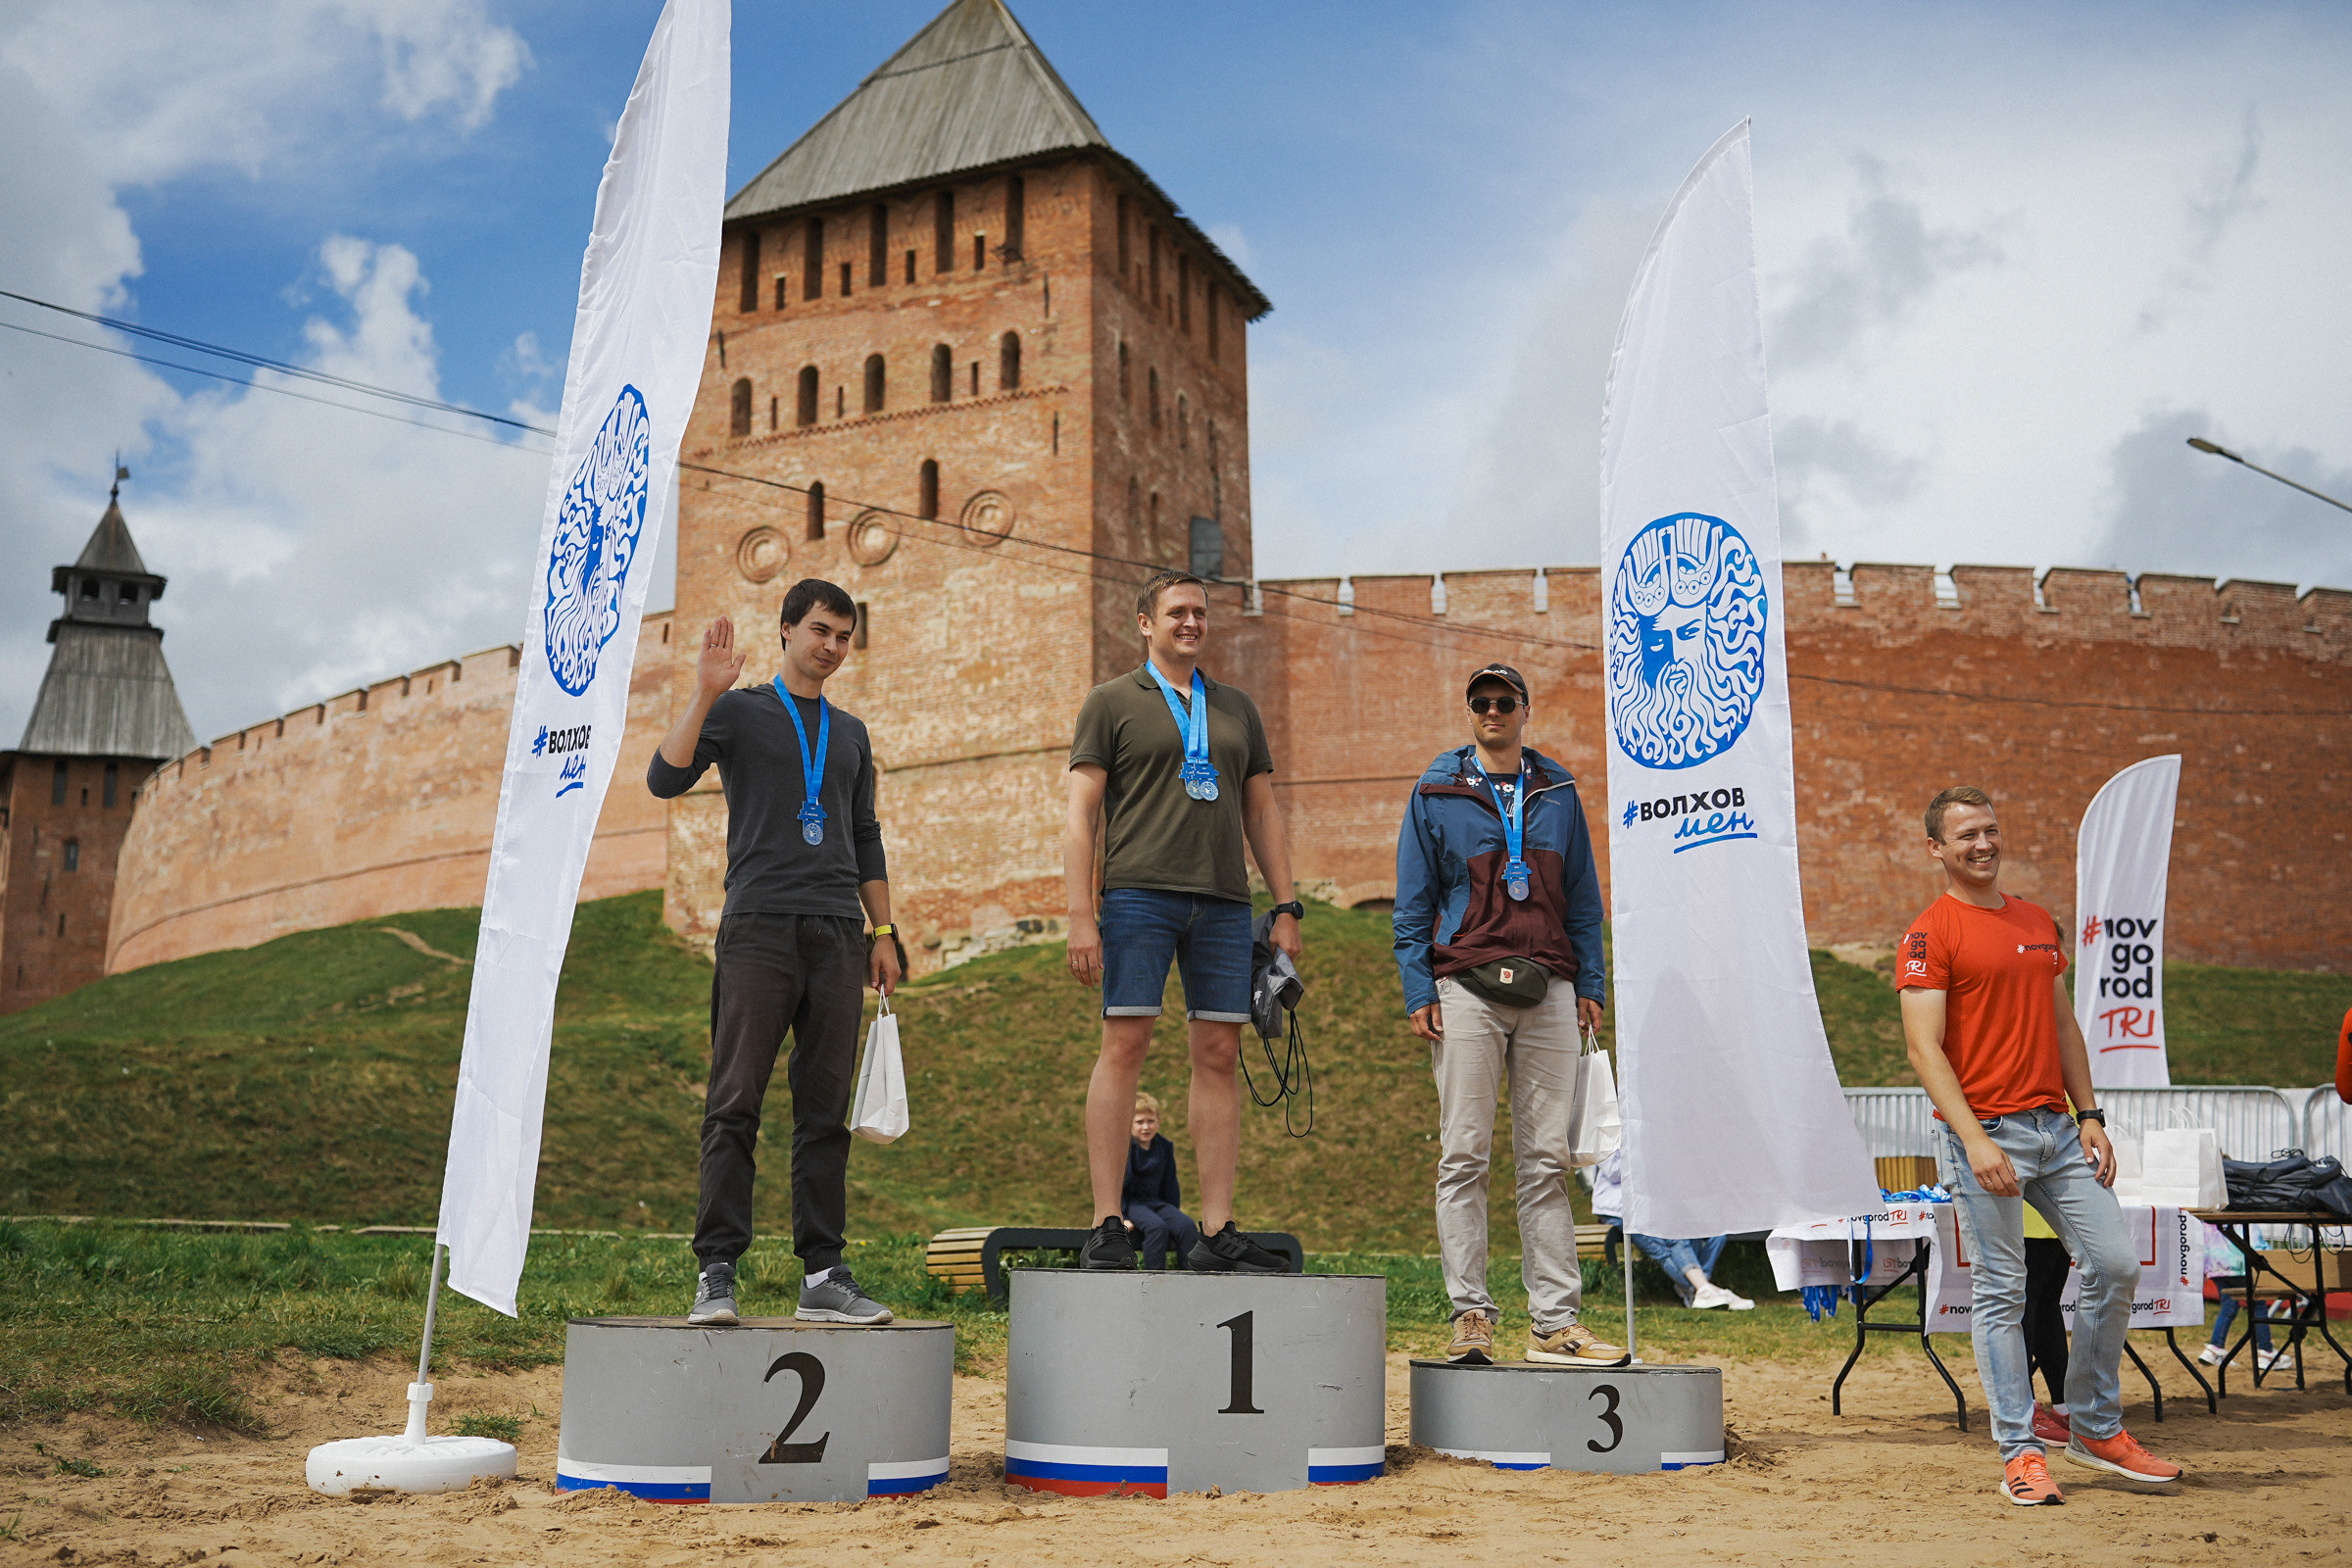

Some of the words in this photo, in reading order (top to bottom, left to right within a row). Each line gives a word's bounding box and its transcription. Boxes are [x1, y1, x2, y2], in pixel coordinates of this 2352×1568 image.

[1623, 787, 1745, 829] #ВОЛХОВ
[1674, 811, 1754, 839] мен
[1911, 940, 1927, 951] go
[2082, 915, 2157, 948] #nov
[1905, 960, 1927, 973] TRI
[1907, 948, 1927, 959] rod
[2112, 944, 2154, 973] go
[2100, 966, 2153, 999] rod
[2099, 1006, 2155, 1038] TRI
[1938, 1304, 1973, 1316] #nov
[1216, 1310, 1264, 1414] 1
[759, 1351, 830, 1465] 2
[1588, 1385, 1623, 1453] 3
